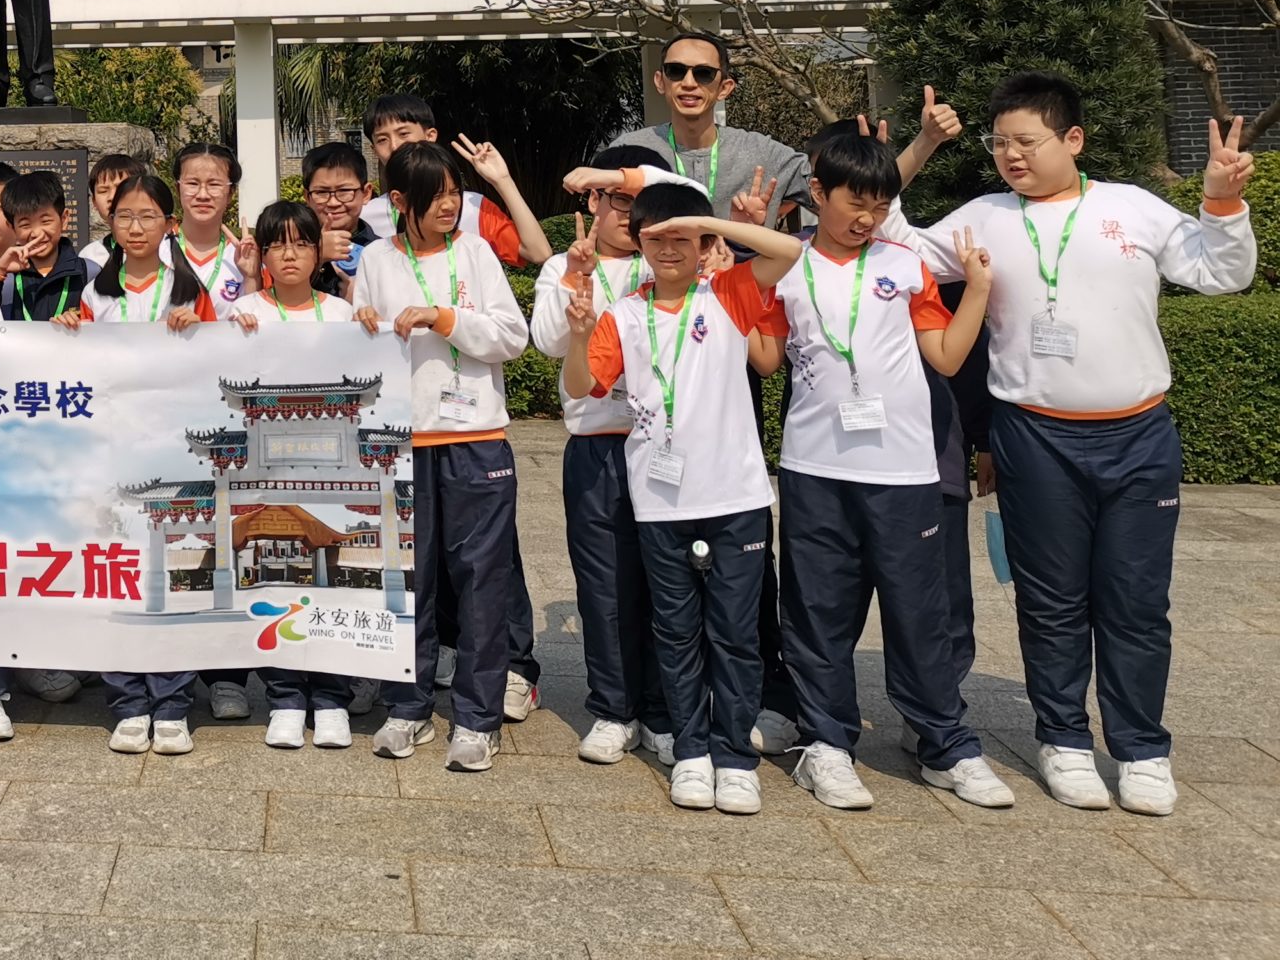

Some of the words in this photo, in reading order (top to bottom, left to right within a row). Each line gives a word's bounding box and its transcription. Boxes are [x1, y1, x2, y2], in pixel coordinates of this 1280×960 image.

[308, 607, 394, 633] 永安旅遊
[308, 628, 335, 638] WING
[341, 630, 356, 640] ON
[361, 633, 394, 645] TRAVEL
